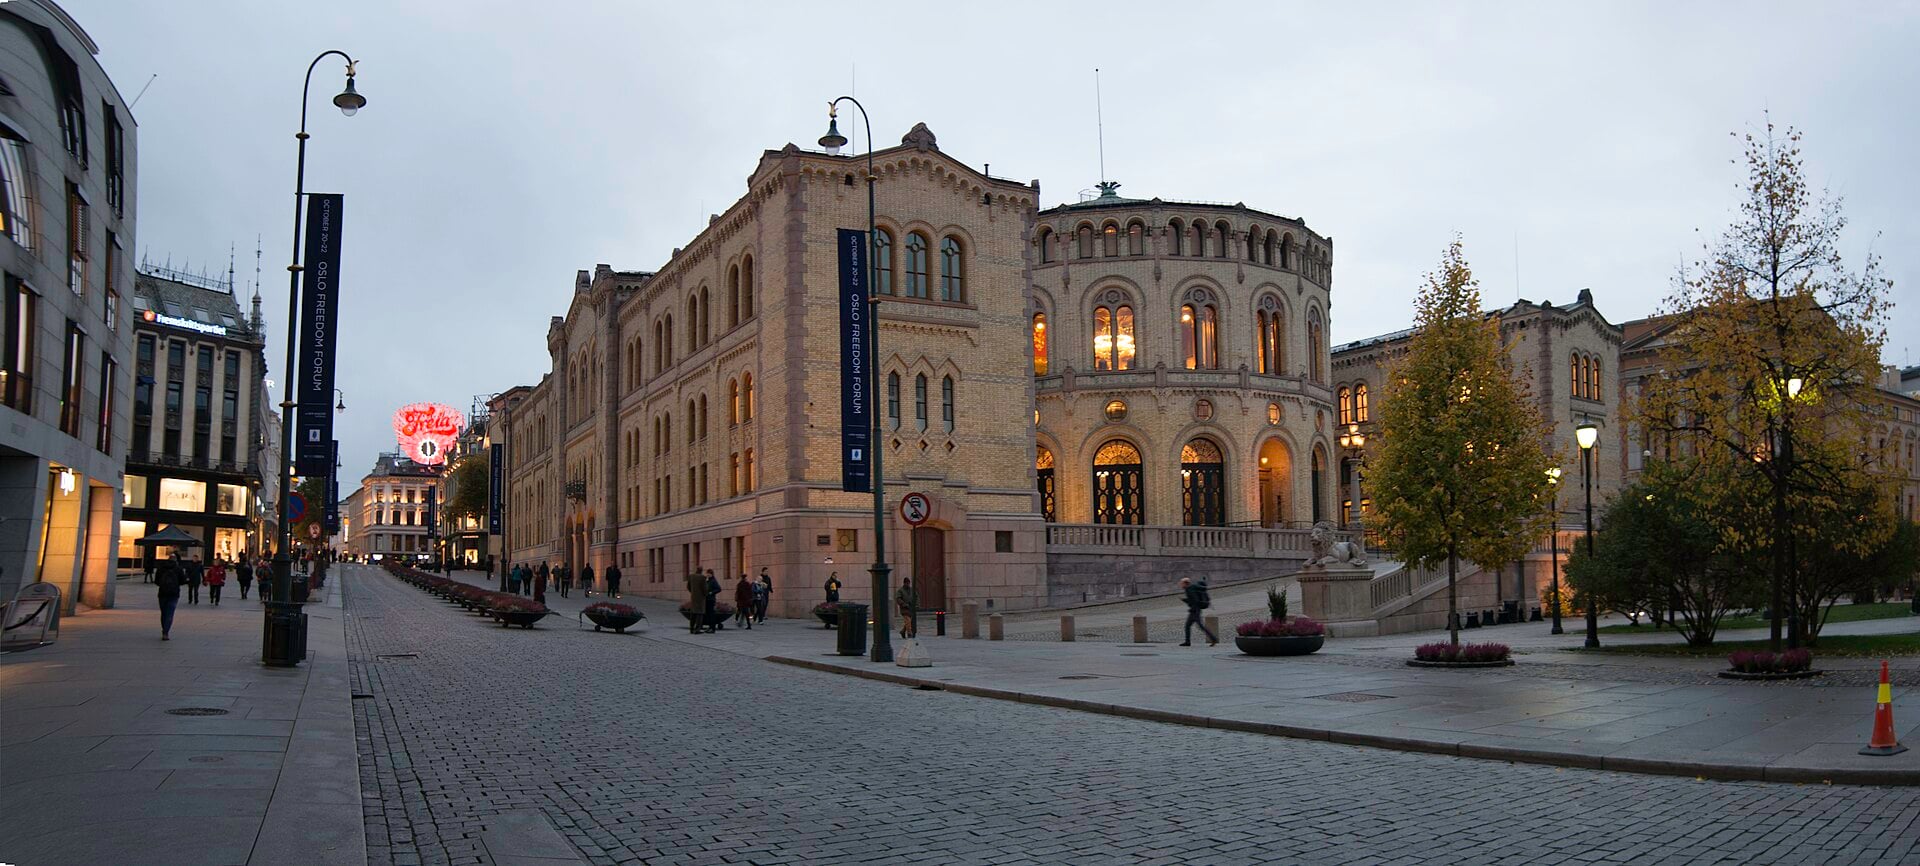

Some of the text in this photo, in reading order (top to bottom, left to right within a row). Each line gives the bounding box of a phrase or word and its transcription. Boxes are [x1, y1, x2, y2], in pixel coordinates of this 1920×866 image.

[321, 199, 331, 253] OCTOBER 20-22
[850, 235, 859, 286] OCTOBER 20-22
[313, 261, 328, 391] OSLO FREEDOM FORUM
[851, 293, 862, 414] OSLO FREEDOM FORUM
[402, 406, 457, 437] Freia
